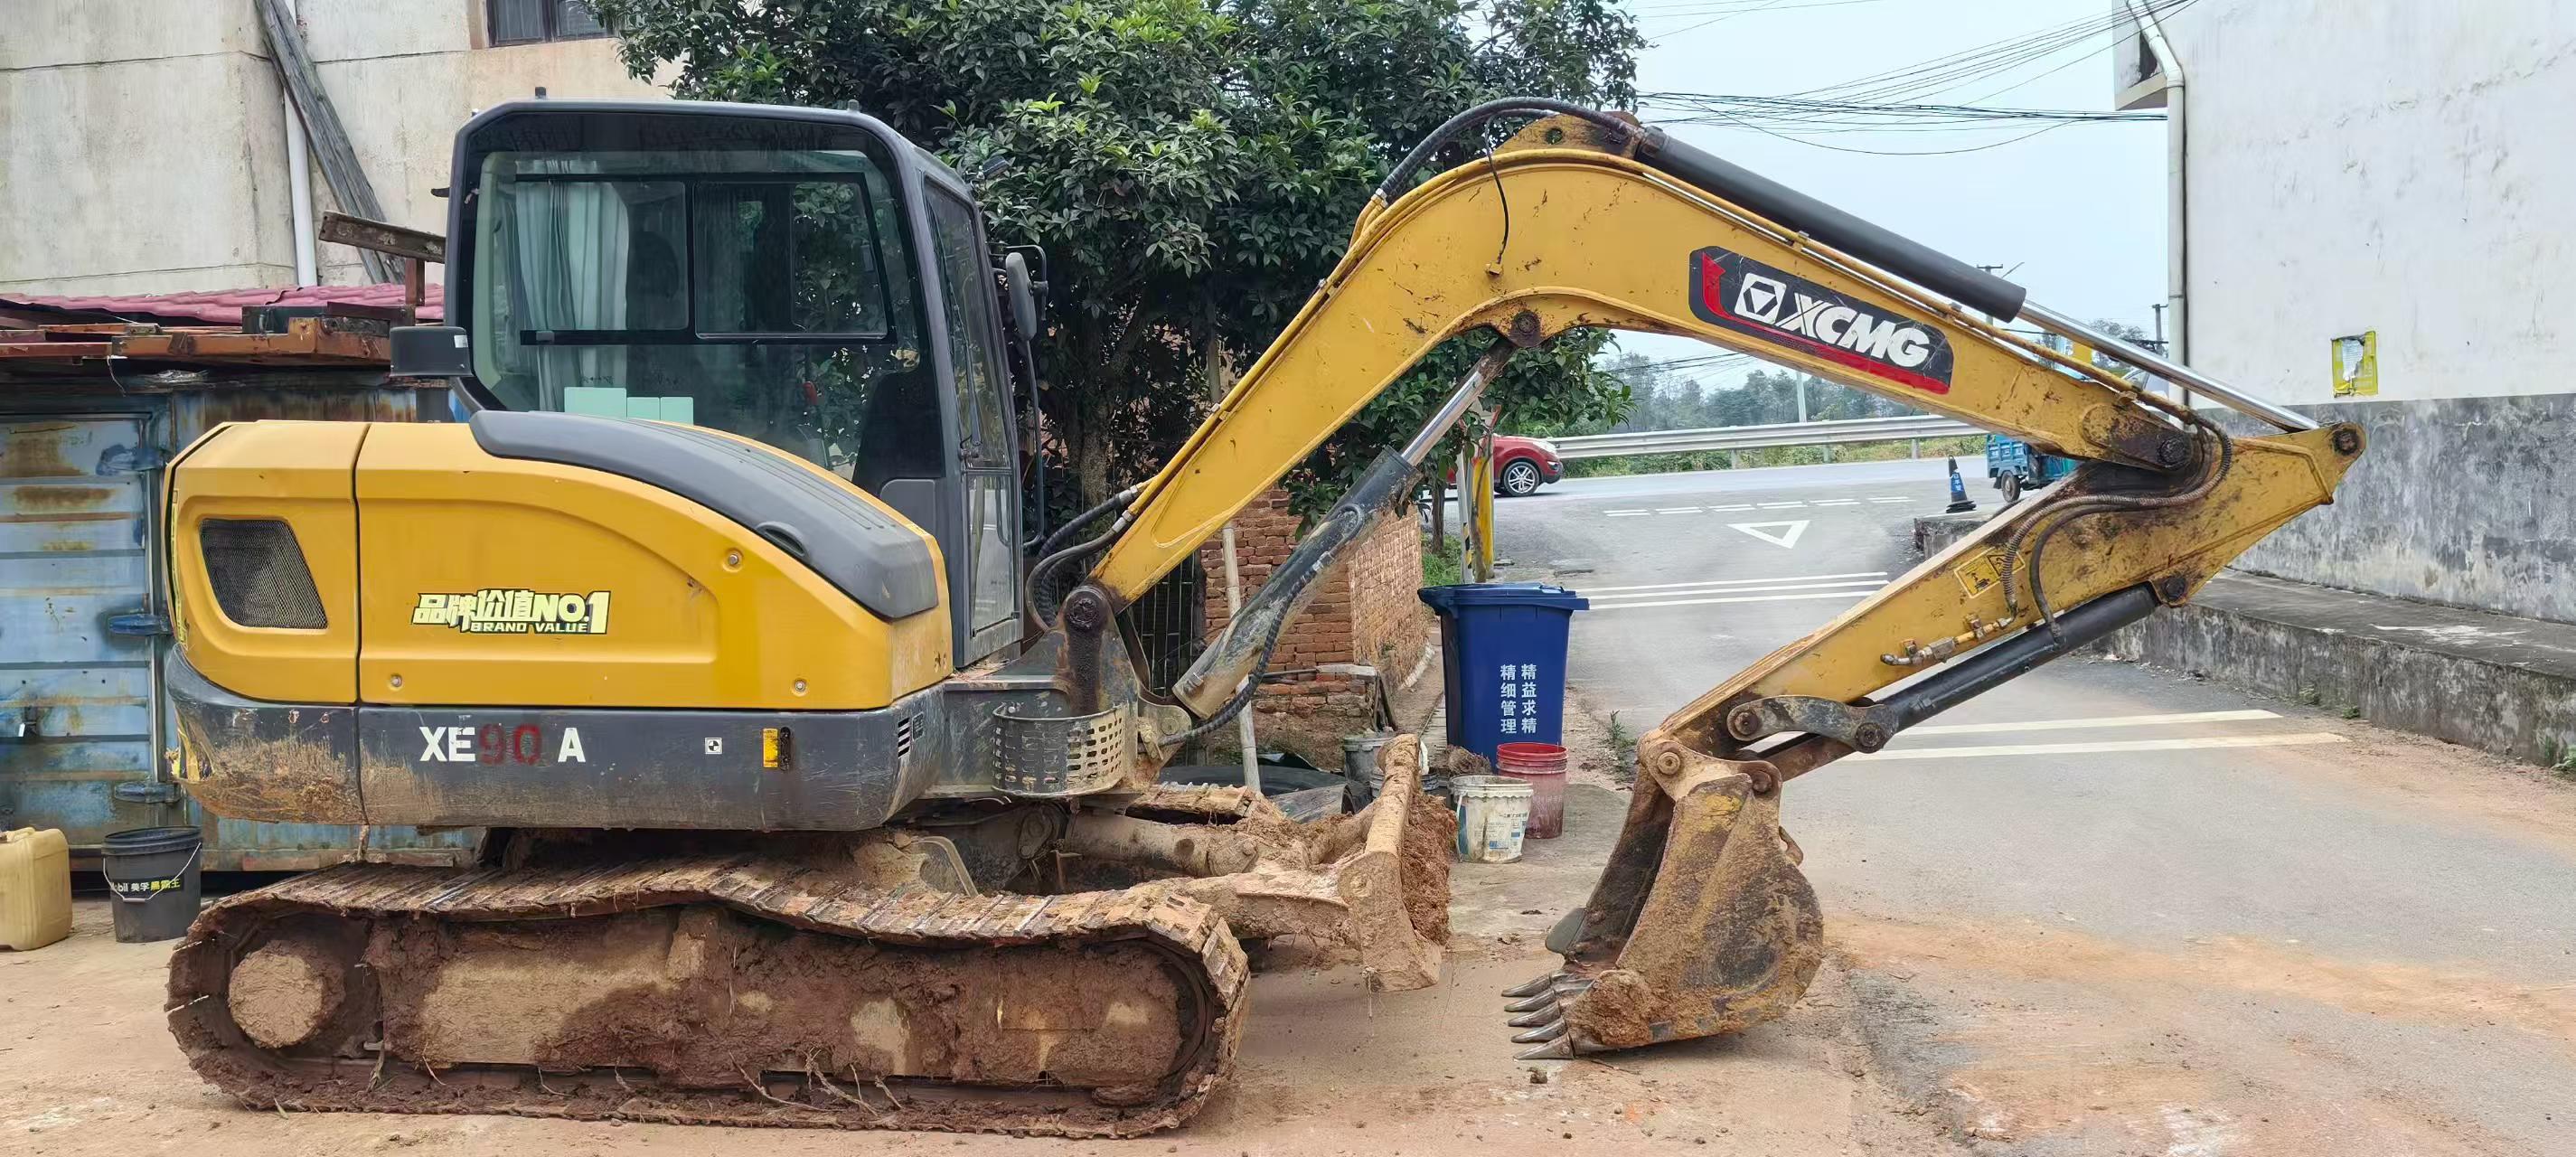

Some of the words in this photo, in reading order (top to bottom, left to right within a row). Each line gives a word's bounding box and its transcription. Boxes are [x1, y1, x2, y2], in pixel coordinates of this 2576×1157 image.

[1773, 292, 1931, 367] XCMG
[470, 622, 527, 633] BRAND
[534, 622, 588, 633] VALUE
[1500, 663, 1517, 734] 精细管理
[1521, 663, 1537, 733] 精益求精
